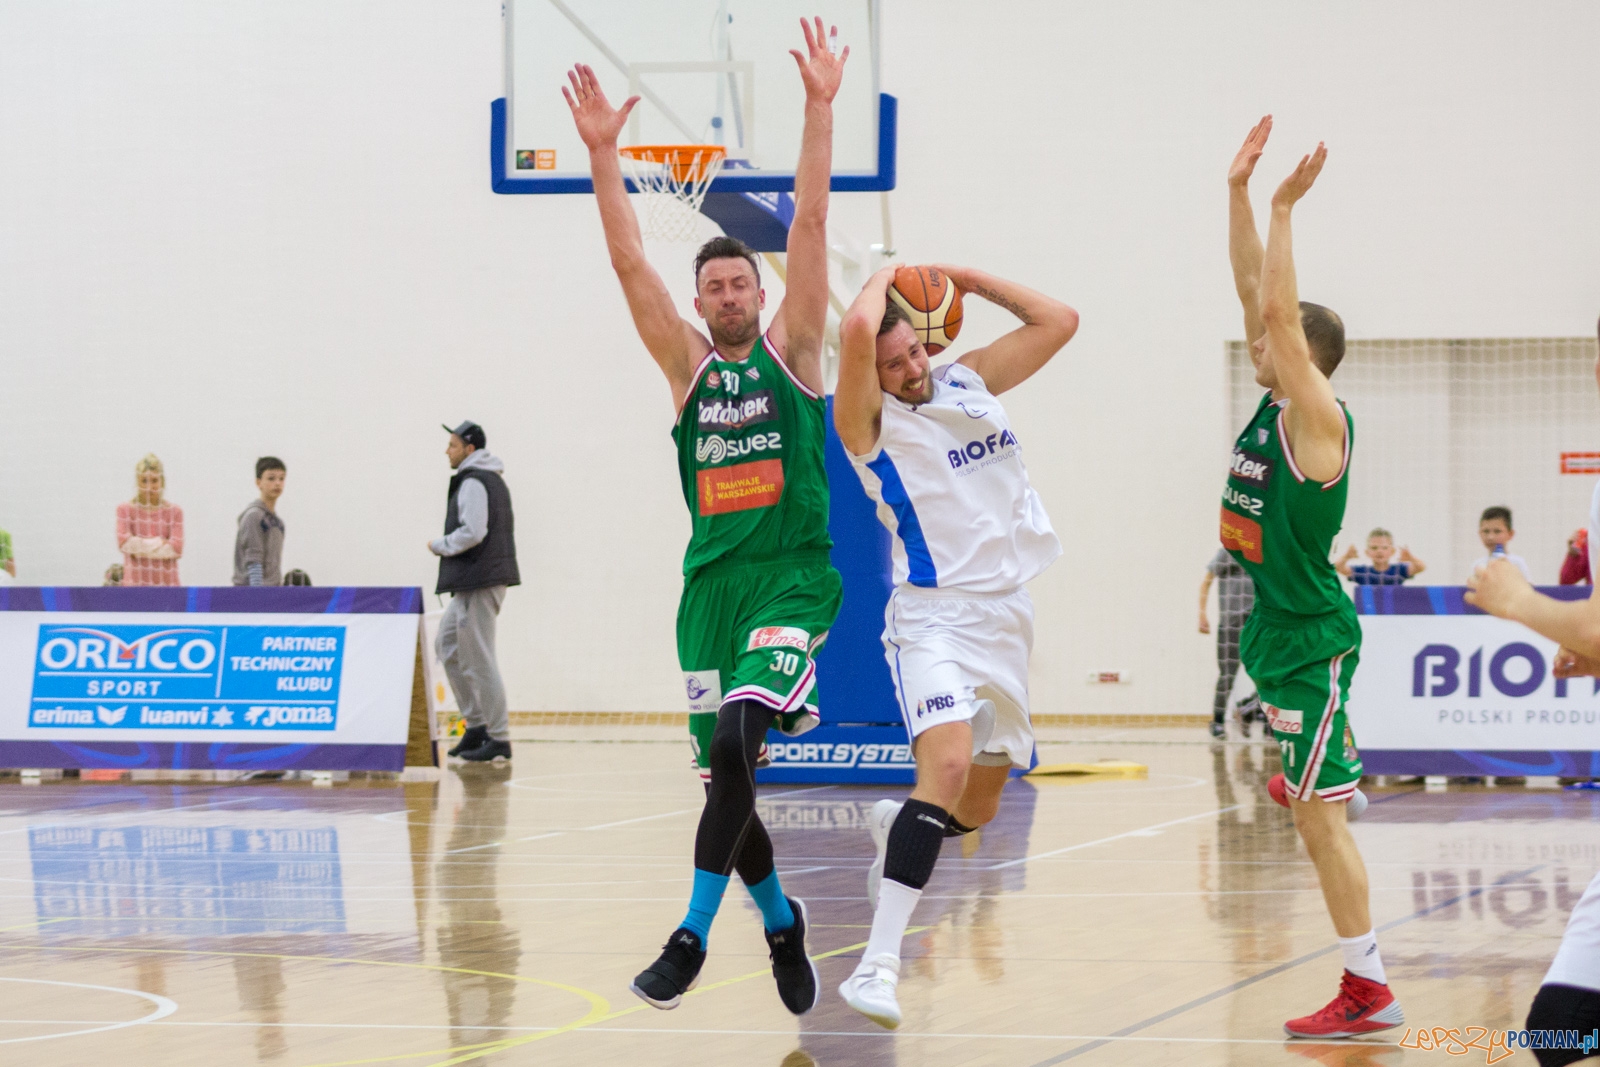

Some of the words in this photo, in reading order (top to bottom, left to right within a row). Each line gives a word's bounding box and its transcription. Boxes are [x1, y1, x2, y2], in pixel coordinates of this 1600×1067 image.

[721, 370, 740, 395] 30
[948, 429, 1018, 469] BIOFA
[716, 476, 760, 491] TRAMWAJE
[717, 484, 776, 500] WARSZAWSKIE
[261, 636, 338, 652] PARTNER
[230, 656, 336, 672] TECHNICZNY
[769, 650, 799, 676] 30
[86, 680, 162, 696] SPORT
[276, 676, 334, 692] KLUBU
[926, 695, 955, 713] PBG
[33, 706, 95, 725] erima
[140, 706, 209, 725] luanvi
[1438, 709, 1512, 724] POLSKI
[1525, 709, 1600, 724] PRODU
[768, 743, 917, 766] PORTSYSTE
